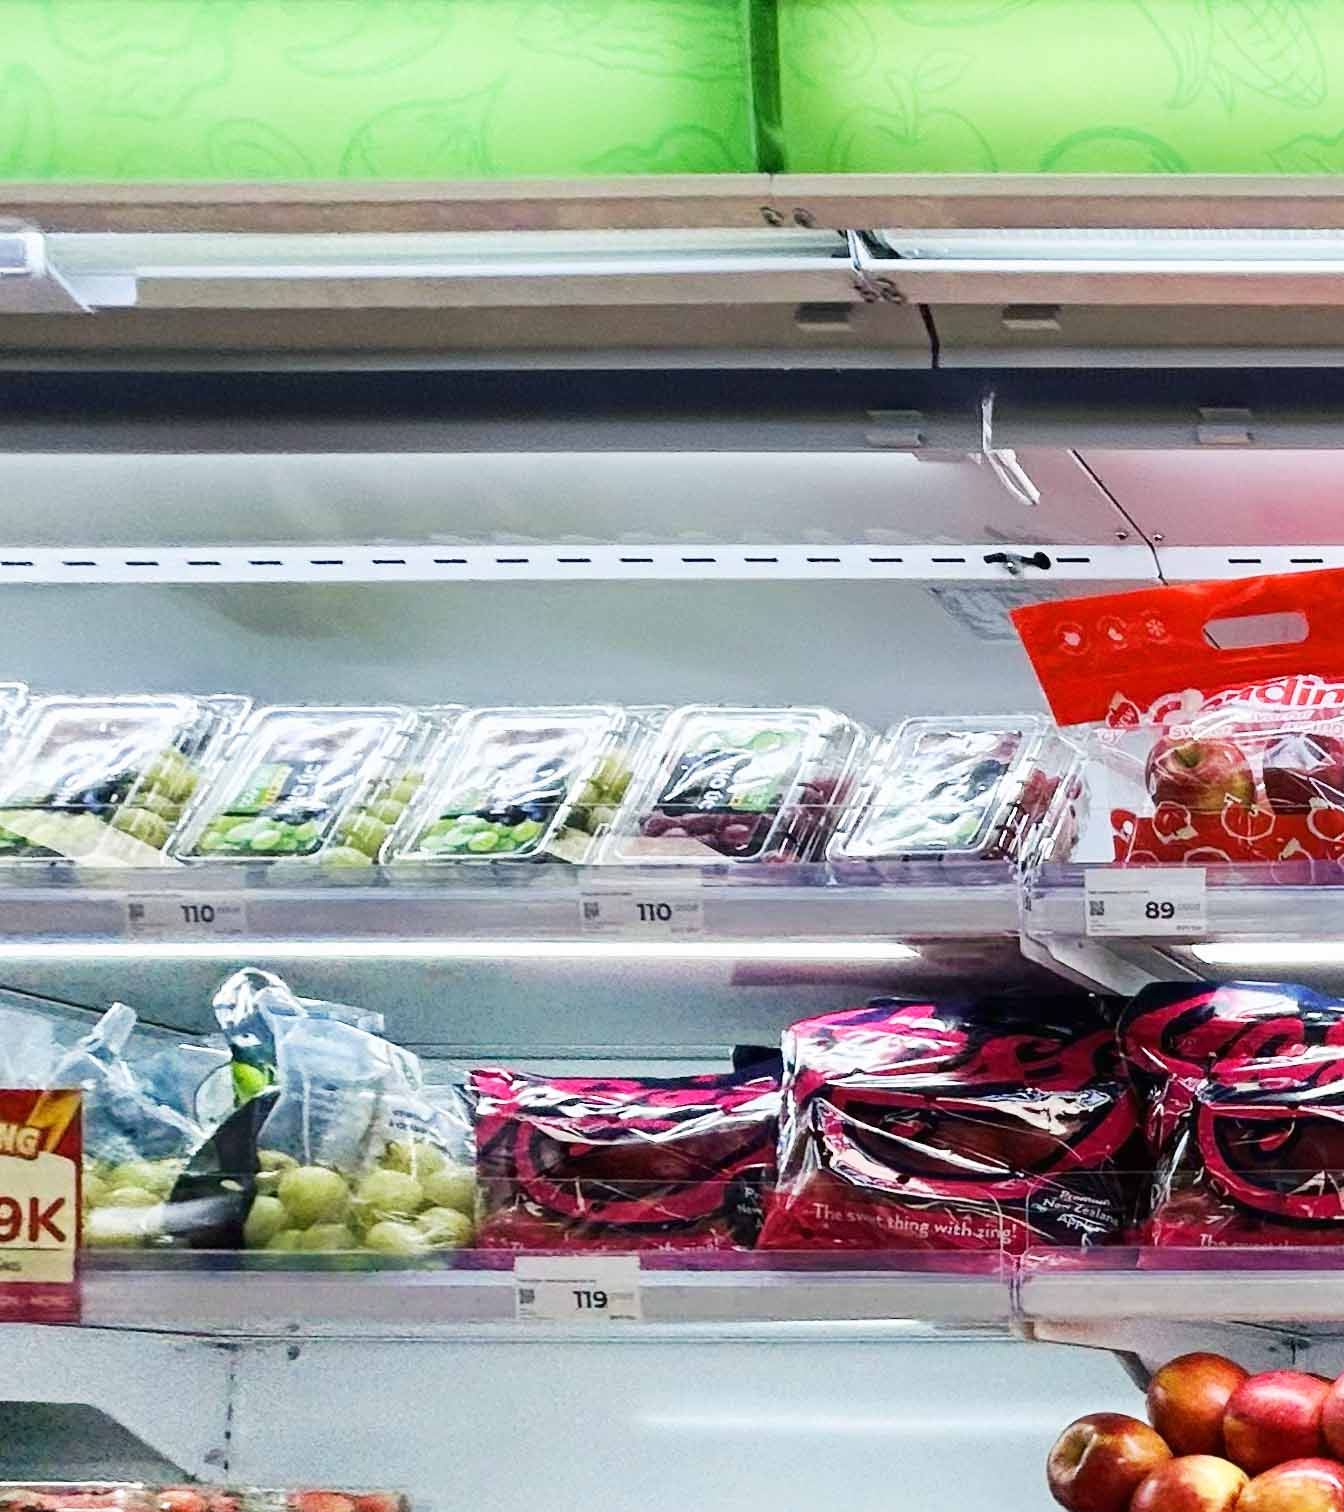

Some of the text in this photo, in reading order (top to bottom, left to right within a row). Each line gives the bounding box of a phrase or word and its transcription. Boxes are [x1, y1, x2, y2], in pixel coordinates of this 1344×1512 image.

[183, 904, 215, 923] 110
[637, 903, 672, 922] 110
[1145, 901, 1175, 920] 89
[812, 1201, 842, 1221] The
[887, 1212, 929, 1239] thing
[933, 1218, 974, 1238] with
[975, 1223, 1018, 1245] zing!
[1073, 1203, 1120, 1225] Zealan
[574, 1290, 608, 1309] 119
